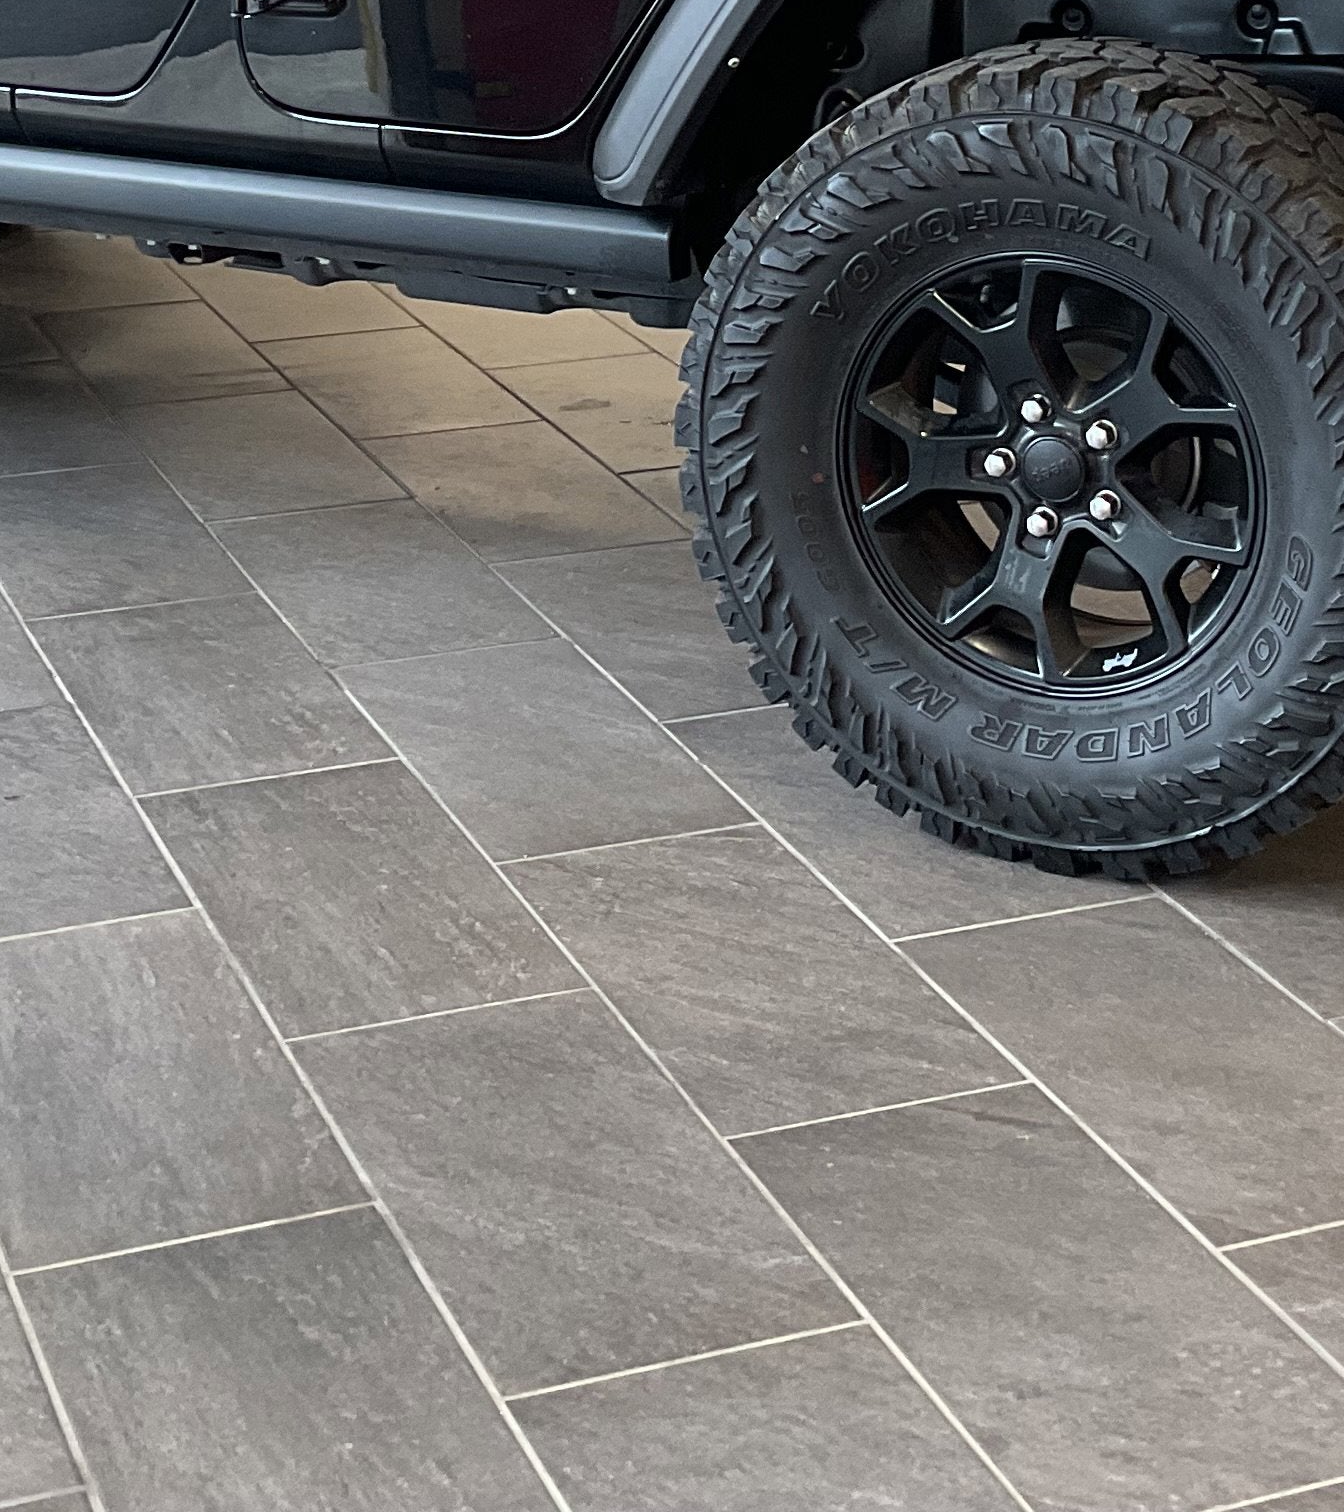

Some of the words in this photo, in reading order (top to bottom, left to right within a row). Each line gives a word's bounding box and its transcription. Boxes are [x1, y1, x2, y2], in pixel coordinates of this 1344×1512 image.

[810, 197, 1152, 321] YOKOHAMA
[830, 615, 958, 722] M/T
[968, 535, 1315, 763] GEOLANDAR
